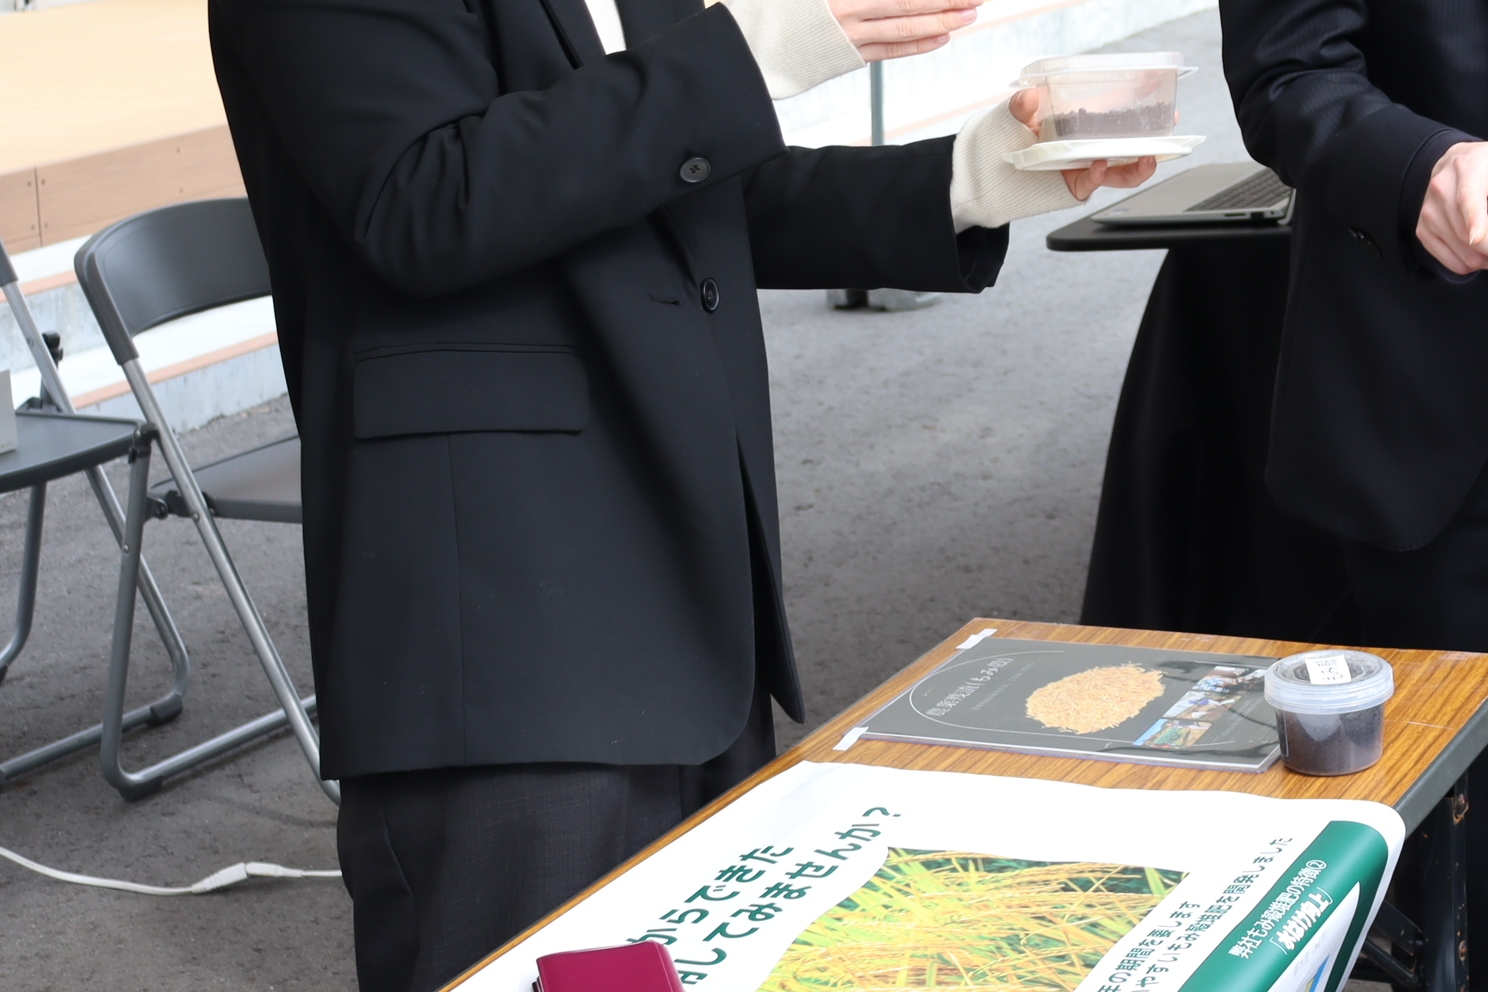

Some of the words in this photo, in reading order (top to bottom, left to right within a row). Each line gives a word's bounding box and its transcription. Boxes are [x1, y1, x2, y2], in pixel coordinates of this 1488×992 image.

[626, 845, 795, 945] からできた
